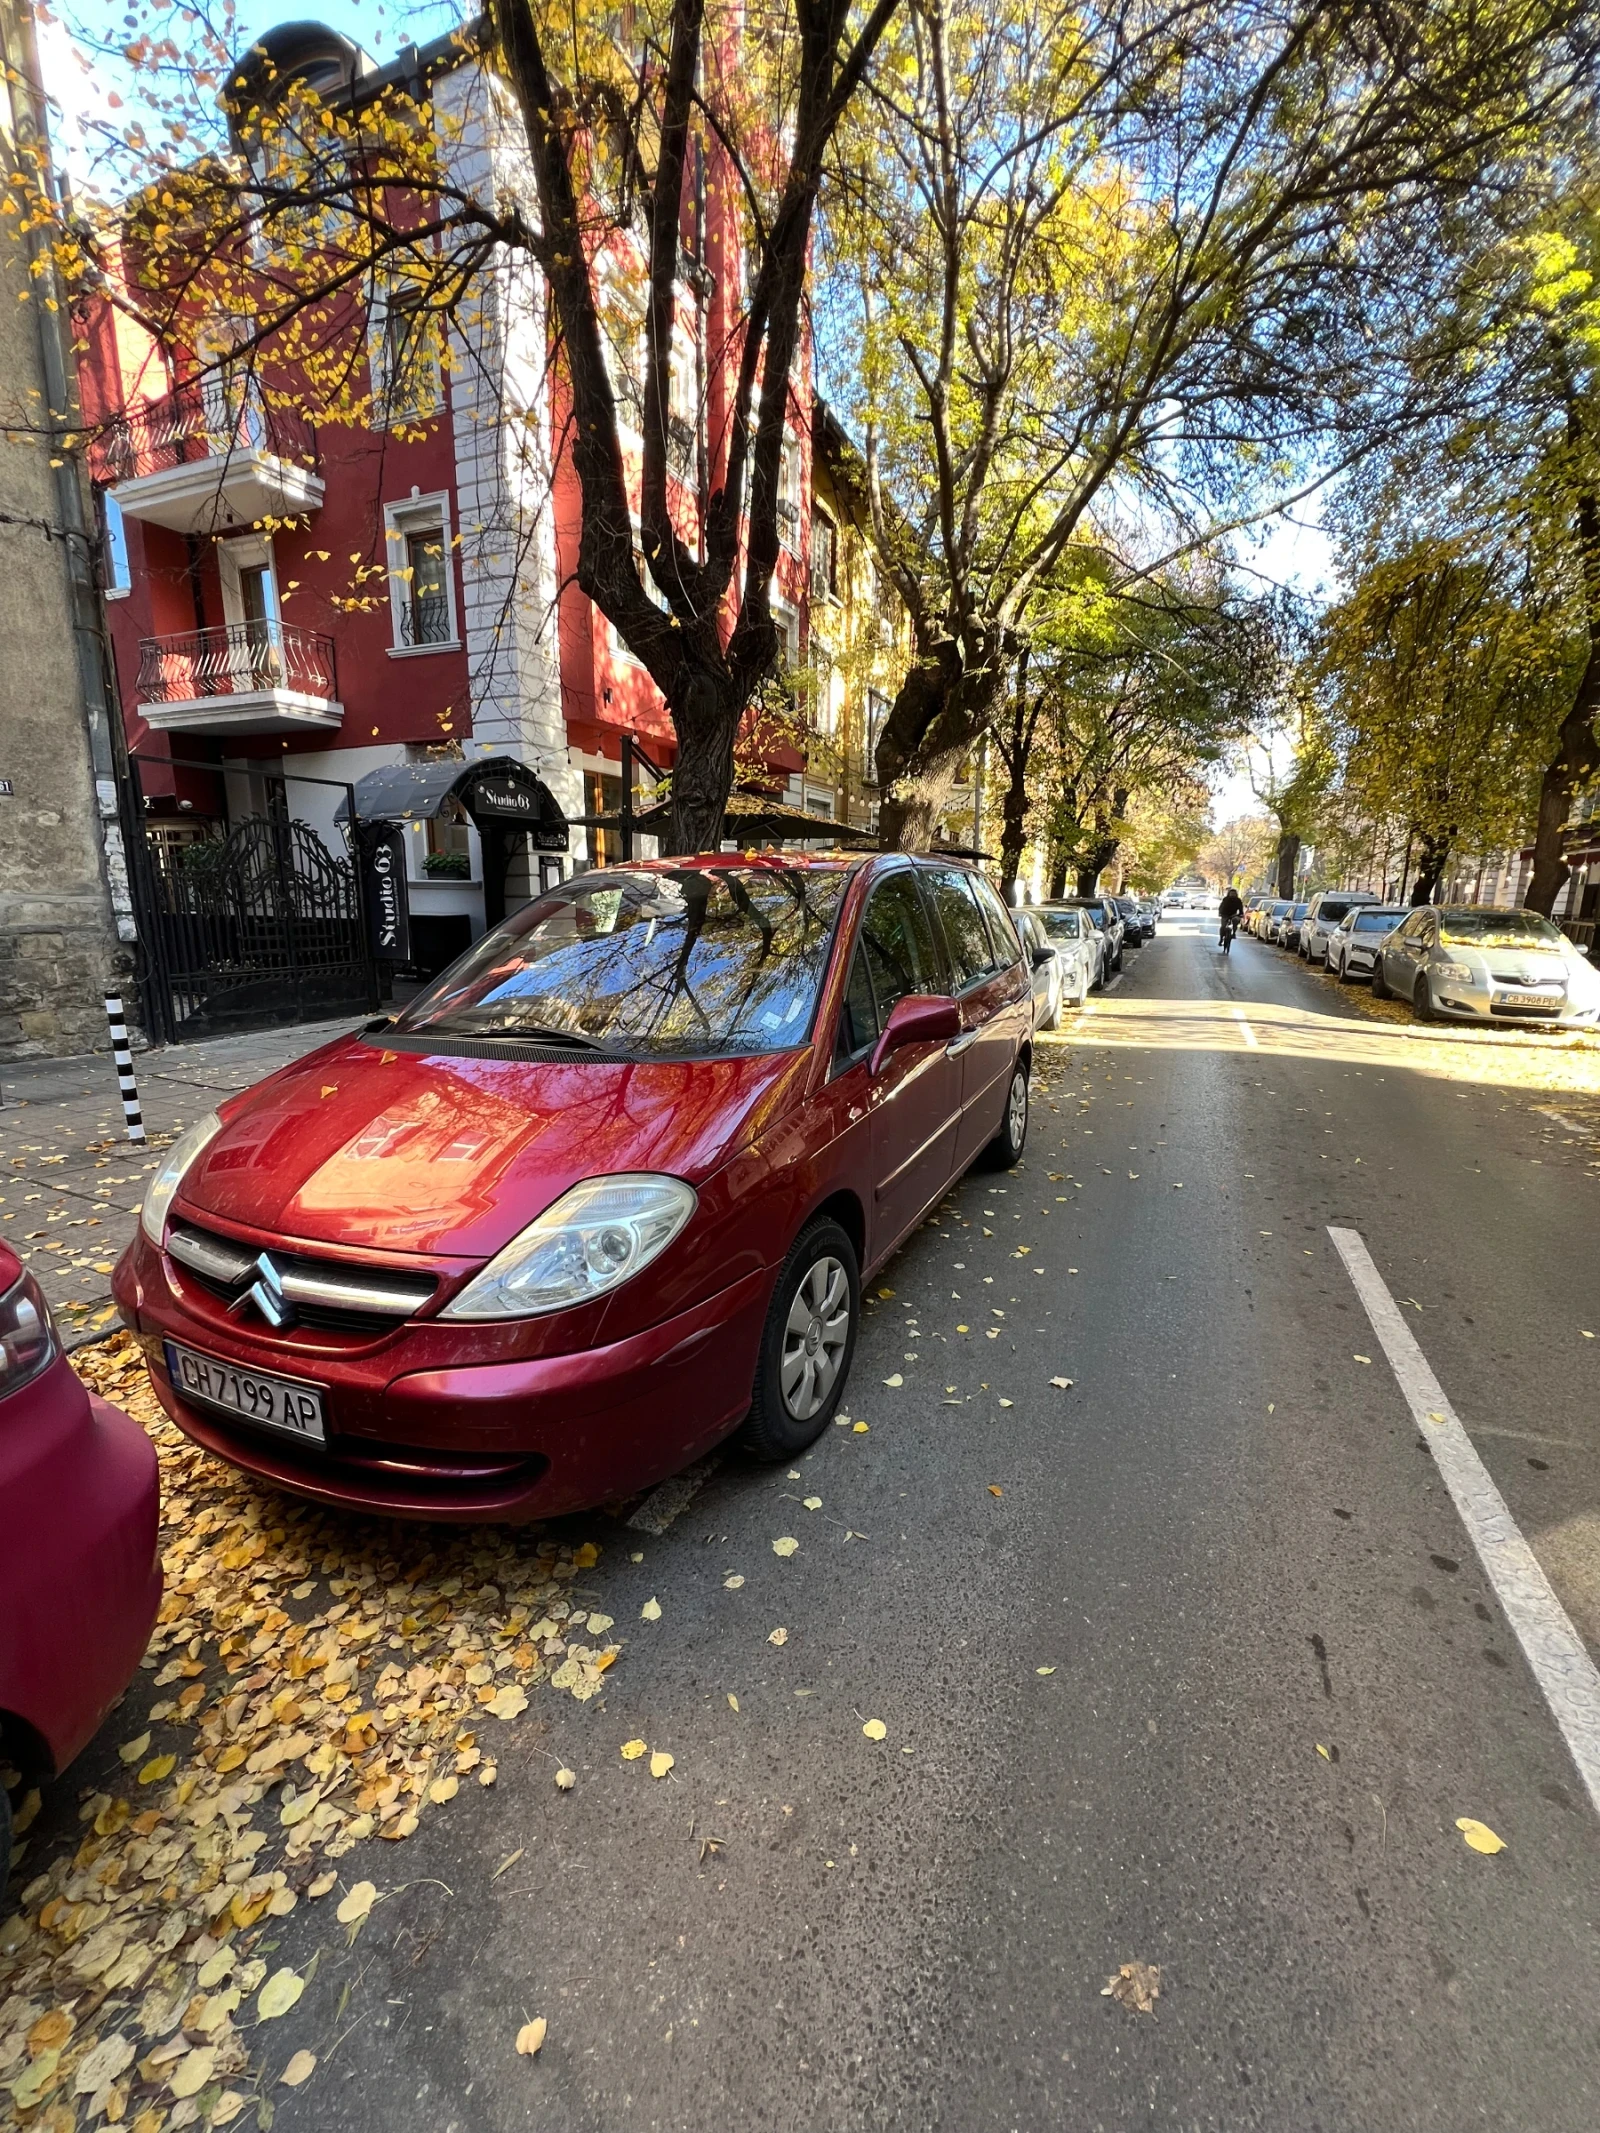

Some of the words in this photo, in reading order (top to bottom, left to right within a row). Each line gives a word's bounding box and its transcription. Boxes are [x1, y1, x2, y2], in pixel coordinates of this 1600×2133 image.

[486, 788, 517, 807] Studio
[517, 793, 530, 810] 63
[374, 844, 394, 873] 63
[380, 876, 396, 947] Studio
[284, 1390, 316, 1430] AP
